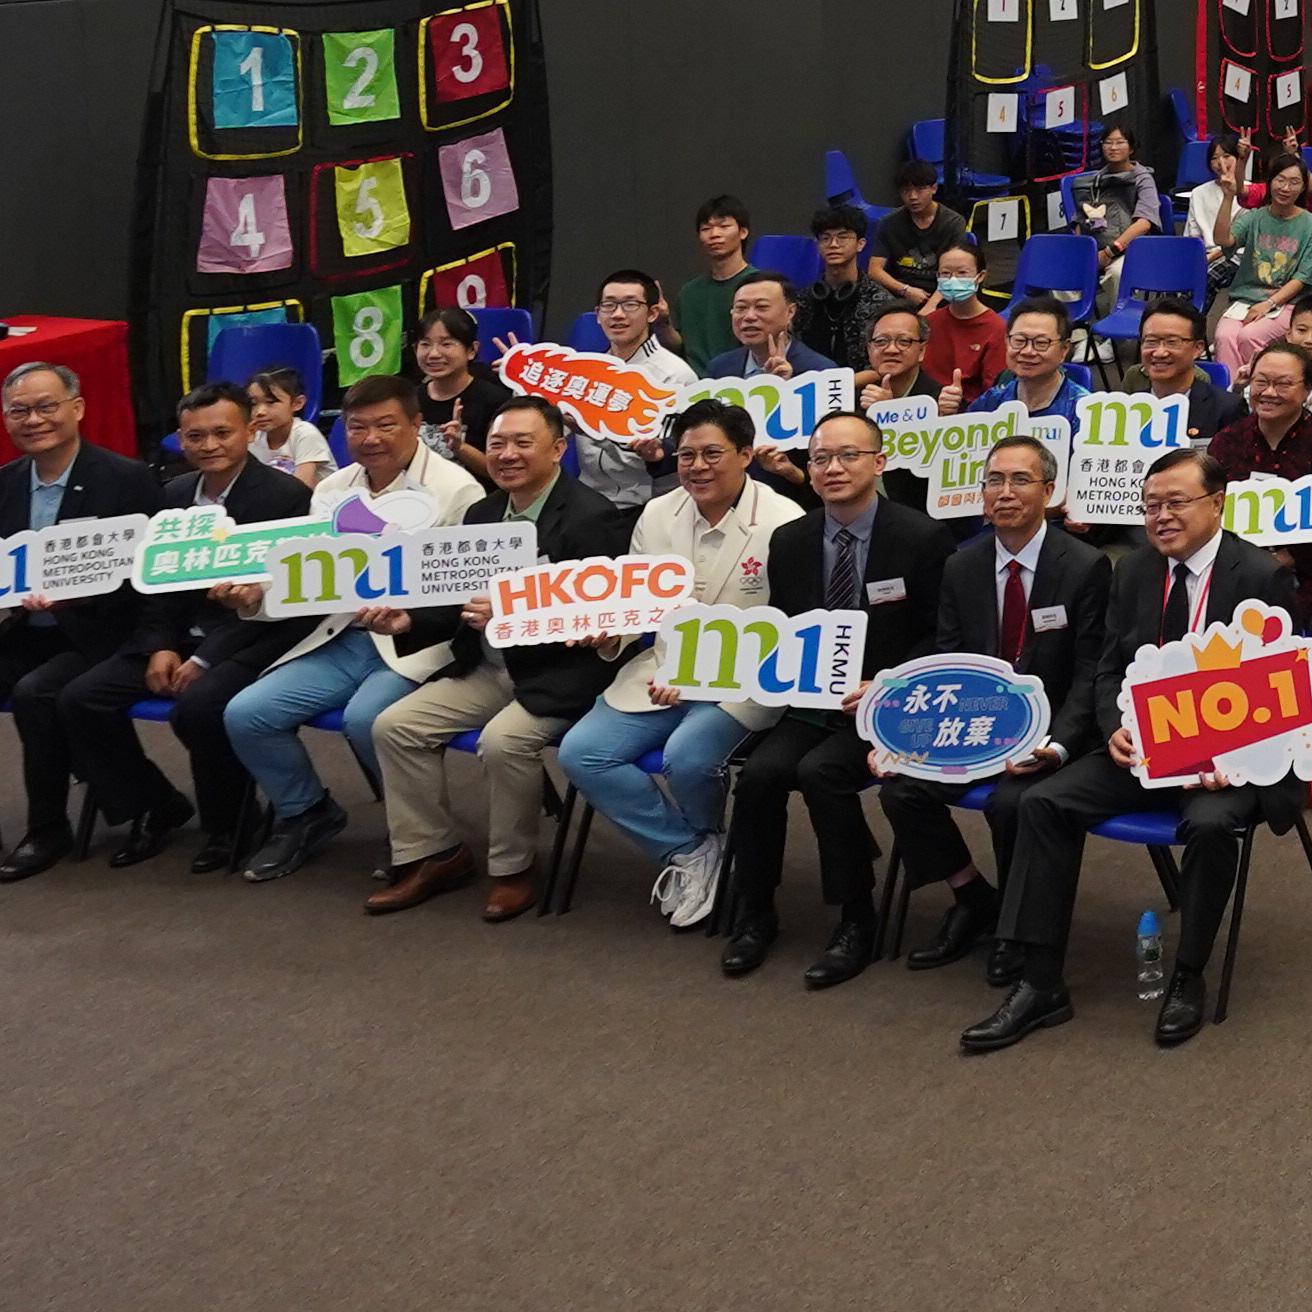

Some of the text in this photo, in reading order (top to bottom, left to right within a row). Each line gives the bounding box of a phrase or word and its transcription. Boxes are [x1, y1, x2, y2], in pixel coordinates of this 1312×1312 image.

[450, 23, 482, 83] 3
[240, 47, 263, 111] 1
[343, 47, 379, 110] 2
[1110, 88, 1119, 102] 6
[998, 106, 1006, 123] 4
[1057, 101, 1065, 117] 5
[460, 150, 491, 208] 6
[353, 178, 383, 239] 5
[230, 193, 266, 258] 4
[349, 306, 384, 367] 8
[519, 357, 634, 413] 追逐奧運夢
[876, 407, 927, 425] Me & U
[1082, 401, 1181, 448] mu
[883, 412, 1015, 465] Beyond
[1080, 457, 1145, 474] 香港都會
[1089, 477, 1126, 487] HONG
[45, 528, 135, 553] 香港都會大學
[154, 512, 217, 541] 共探
[43, 547, 114, 565] HONG KONG
[421, 555, 500, 570] HONG KONG
[422, 536, 523, 556] 香港都會大學
[42, 572, 114, 590] UNIVERSITY
[43, 557, 135, 578] METROPOLITAN
[280, 545, 409, 605] mu
[421, 580, 490, 595] UNIVERSIT
[498, 562, 686, 616] HKOFC
[494, 606, 664, 640] 香港奧林匹克之
[668, 618, 823, 693] mu
[829, 624, 852, 695] HKMU
[903, 683, 963, 714] 永不
[1147, 670, 1299, 744] NO.1
[933, 715, 996, 747] 放棄
